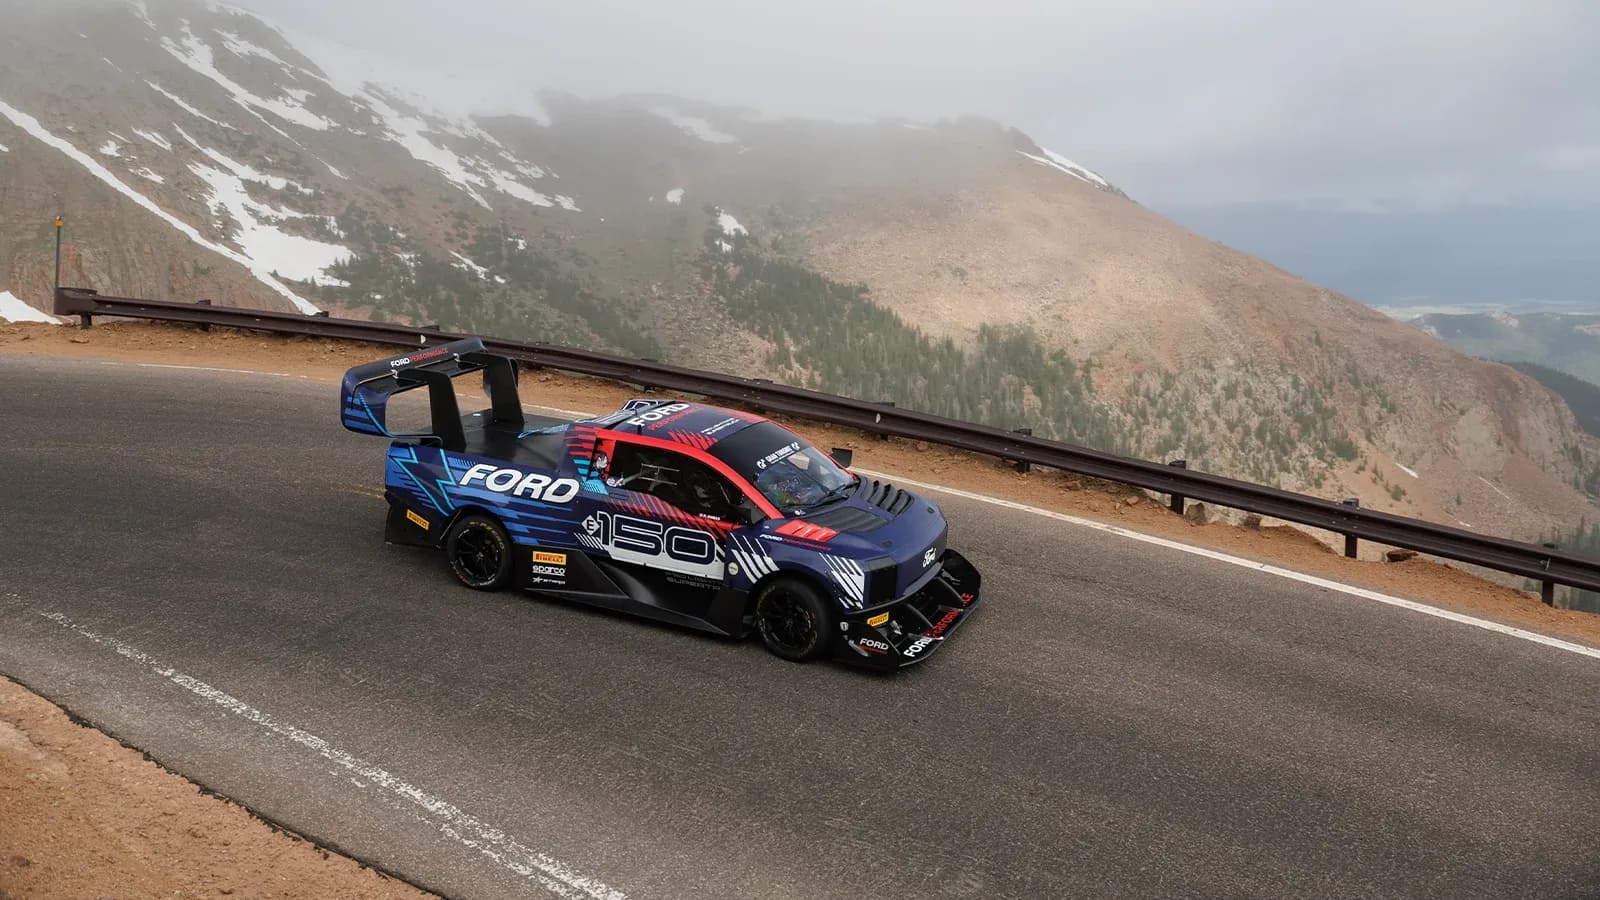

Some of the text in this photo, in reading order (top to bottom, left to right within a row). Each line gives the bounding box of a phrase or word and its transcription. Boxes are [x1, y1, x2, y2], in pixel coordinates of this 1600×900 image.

[390, 357, 410, 367] FORD
[627, 403, 690, 427] FORD
[459, 463, 580, 504] FORD
[597, 511, 716, 565] 150
[535, 552, 564, 564] PIRELLI
[532, 564, 566, 577] sparco
[860, 637, 889, 650] FORD
